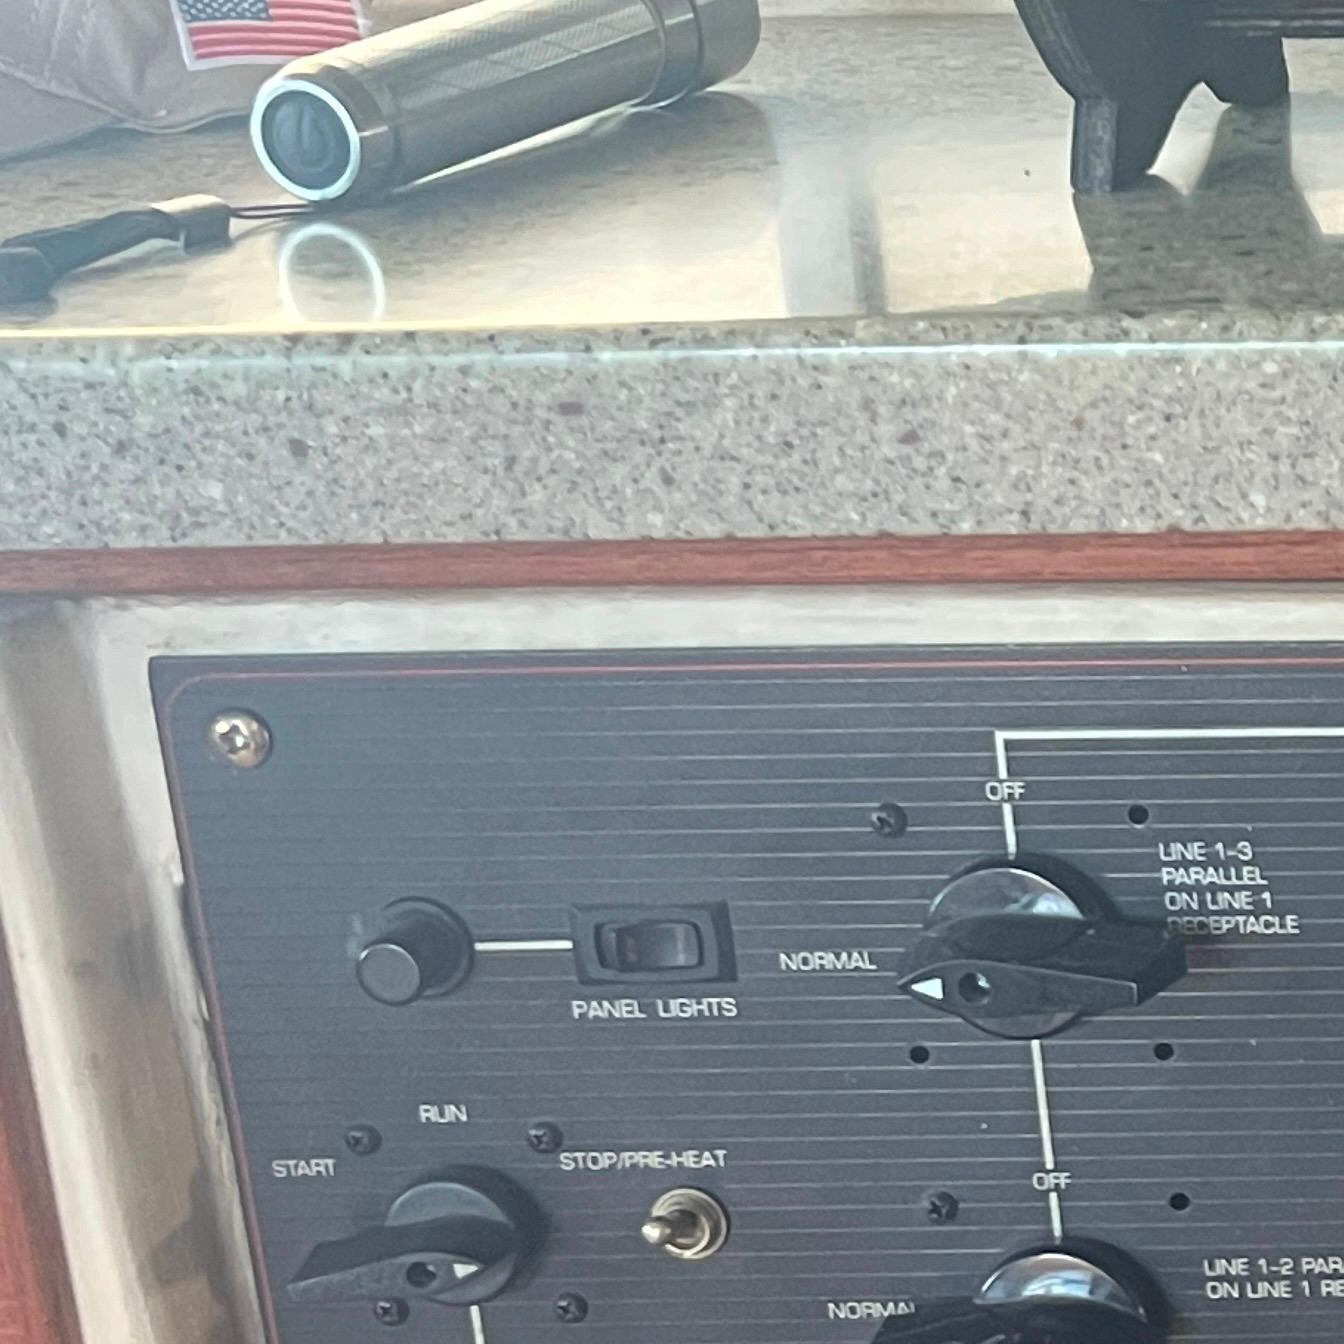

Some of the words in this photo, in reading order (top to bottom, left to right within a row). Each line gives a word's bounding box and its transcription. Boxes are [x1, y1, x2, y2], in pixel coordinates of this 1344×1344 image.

[985, 781, 1025, 801] OFF
[1158, 842, 1206, 861] LINE
[1216, 842, 1252, 860] 1-3
[1162, 867, 1268, 886] PARALLEL
[1165, 892, 1198, 910] ON
[1206, 891, 1254, 910] LINE
[1263, 891, 1271, 909] 1
[780, 951, 877, 970] NORMAL
[572, 999, 646, 1019] PANEL
[656, 998, 737, 1017] LIGHTS
[419, 1104, 468, 1124] RUN
[272, 1159, 336, 1178] START
[560, 1150, 728, 1170] STOP/PRE-HEAT
[1033, 1172, 1071, 1191] OFF
[1204, 1257, 1249, 1276] LINE
[1258, 1257, 1293, 1276] 1-2
[1206, 1280, 1239, 1298] ON
[1247, 1280, 1294, 1298] LINE
[1303, 1279, 1311, 1297] 1
